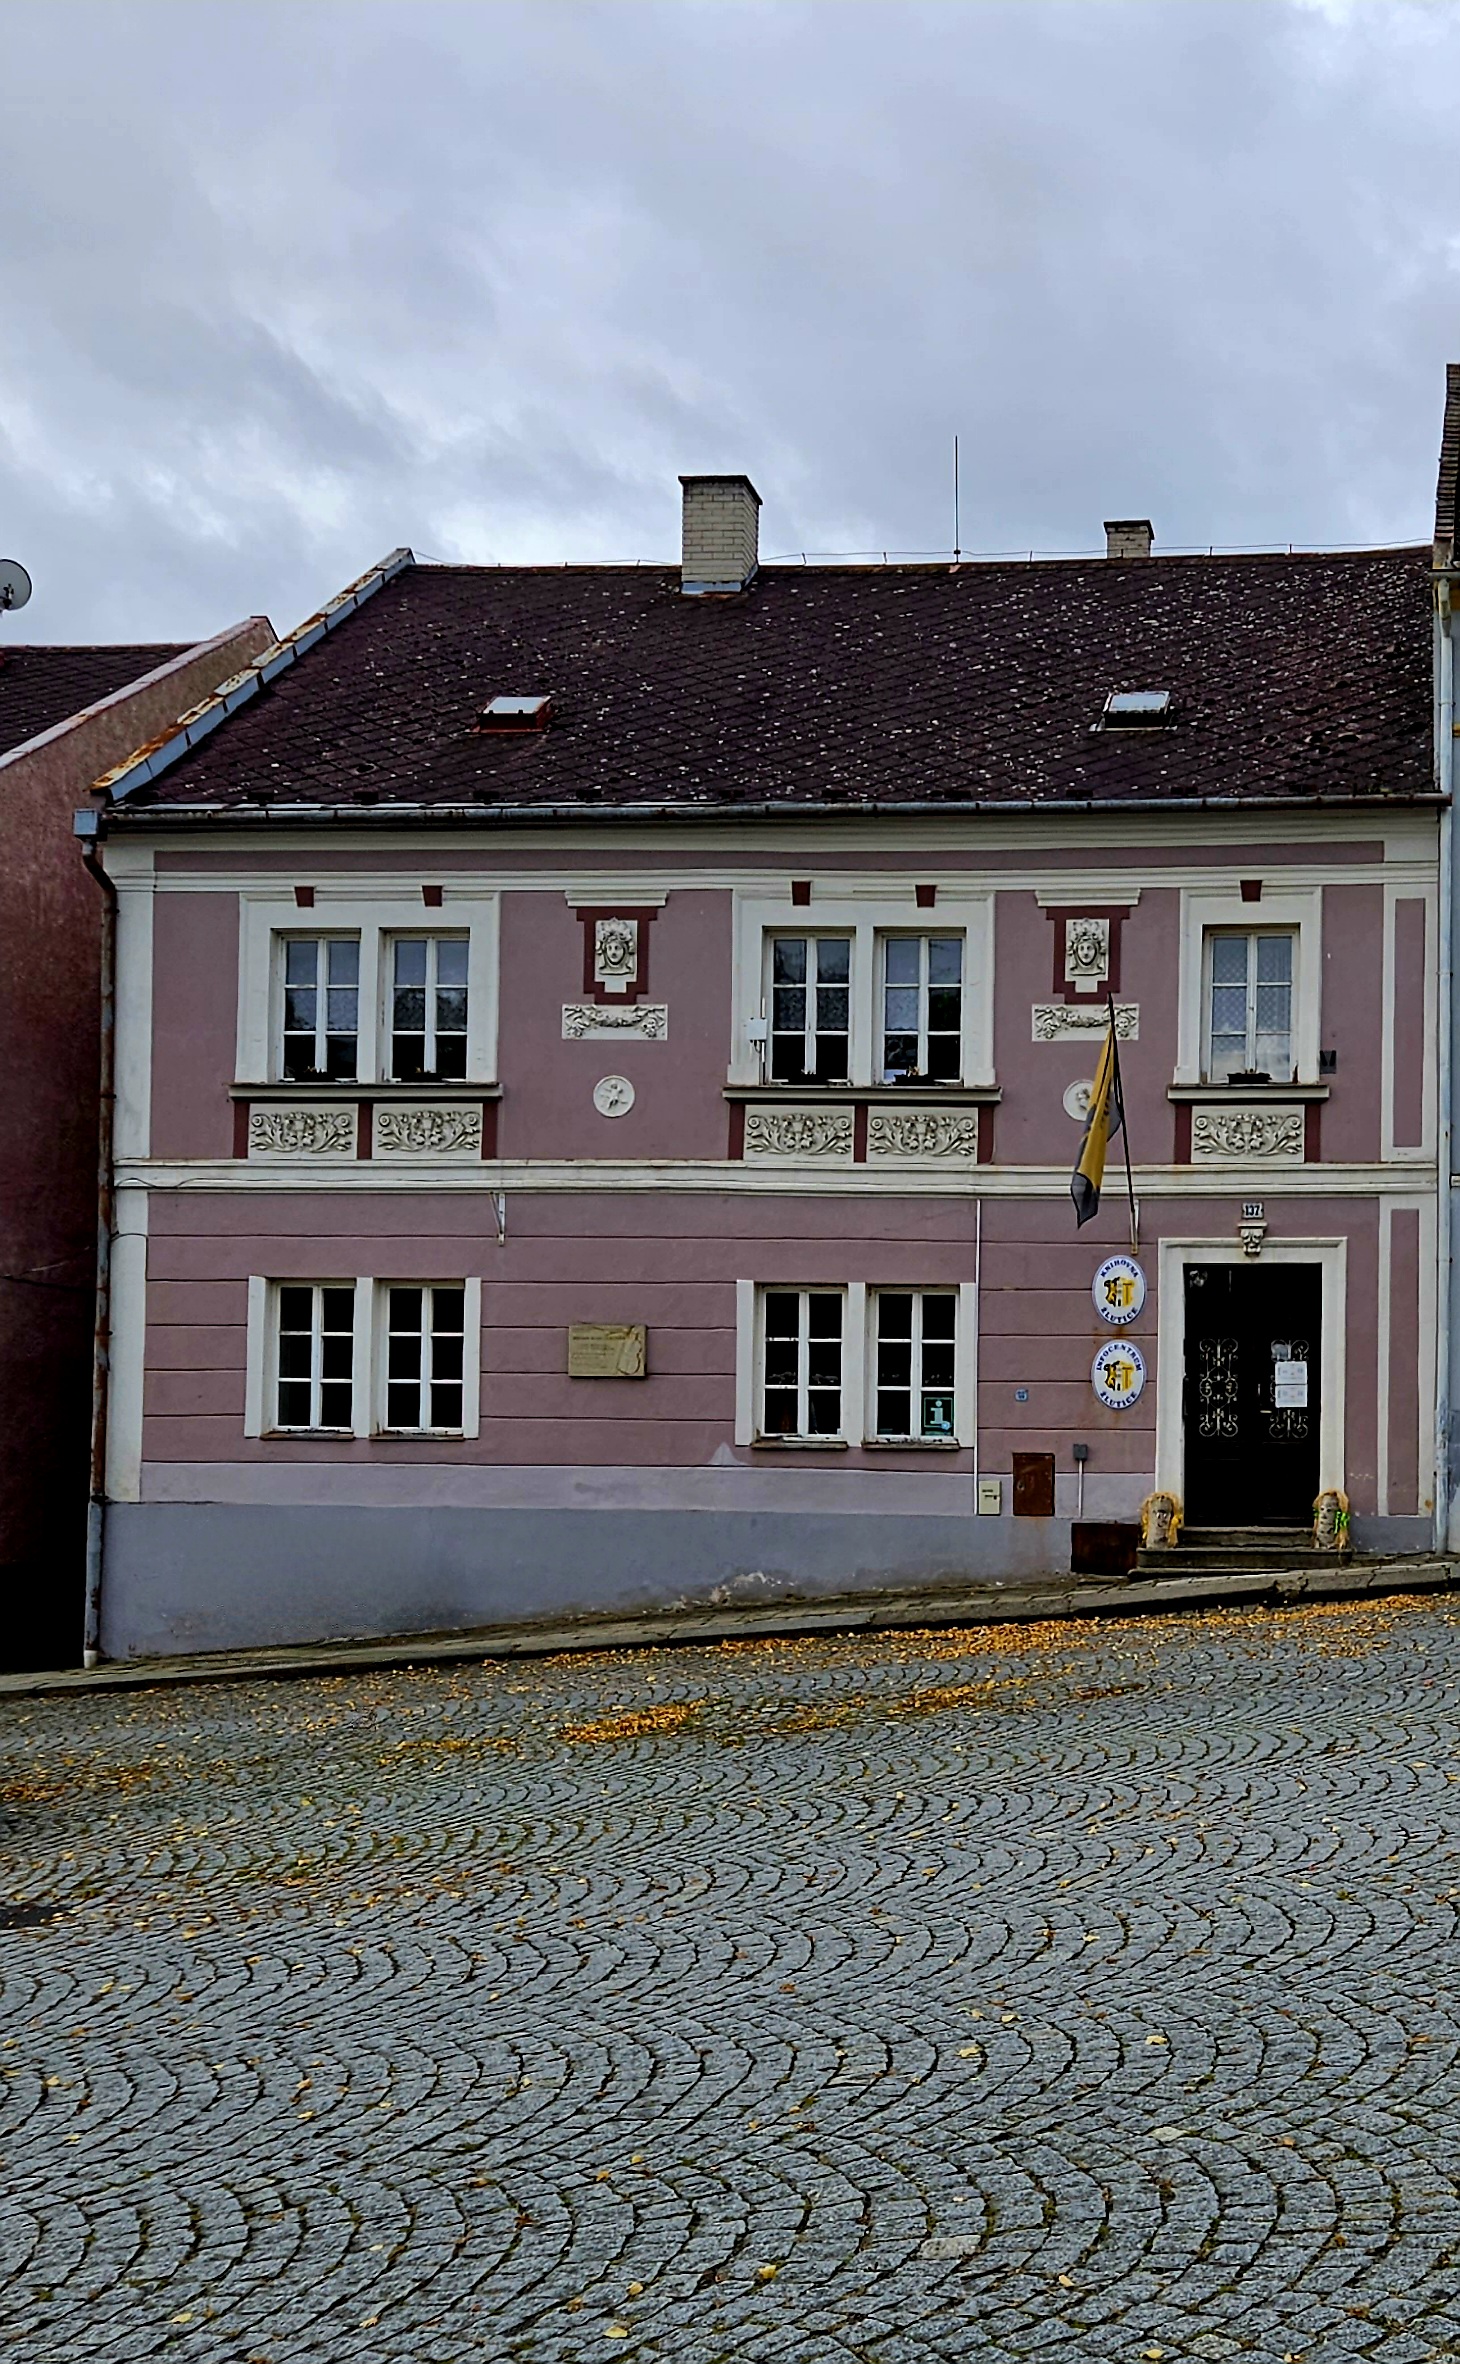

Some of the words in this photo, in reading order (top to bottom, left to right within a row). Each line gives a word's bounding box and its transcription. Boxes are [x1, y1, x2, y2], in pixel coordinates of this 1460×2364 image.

[1245, 1204, 1260, 1216] 137
[1100, 1259, 1139, 1278] KNIHOVNA
[1096, 1343, 1142, 1371] INFOCENTRUM
